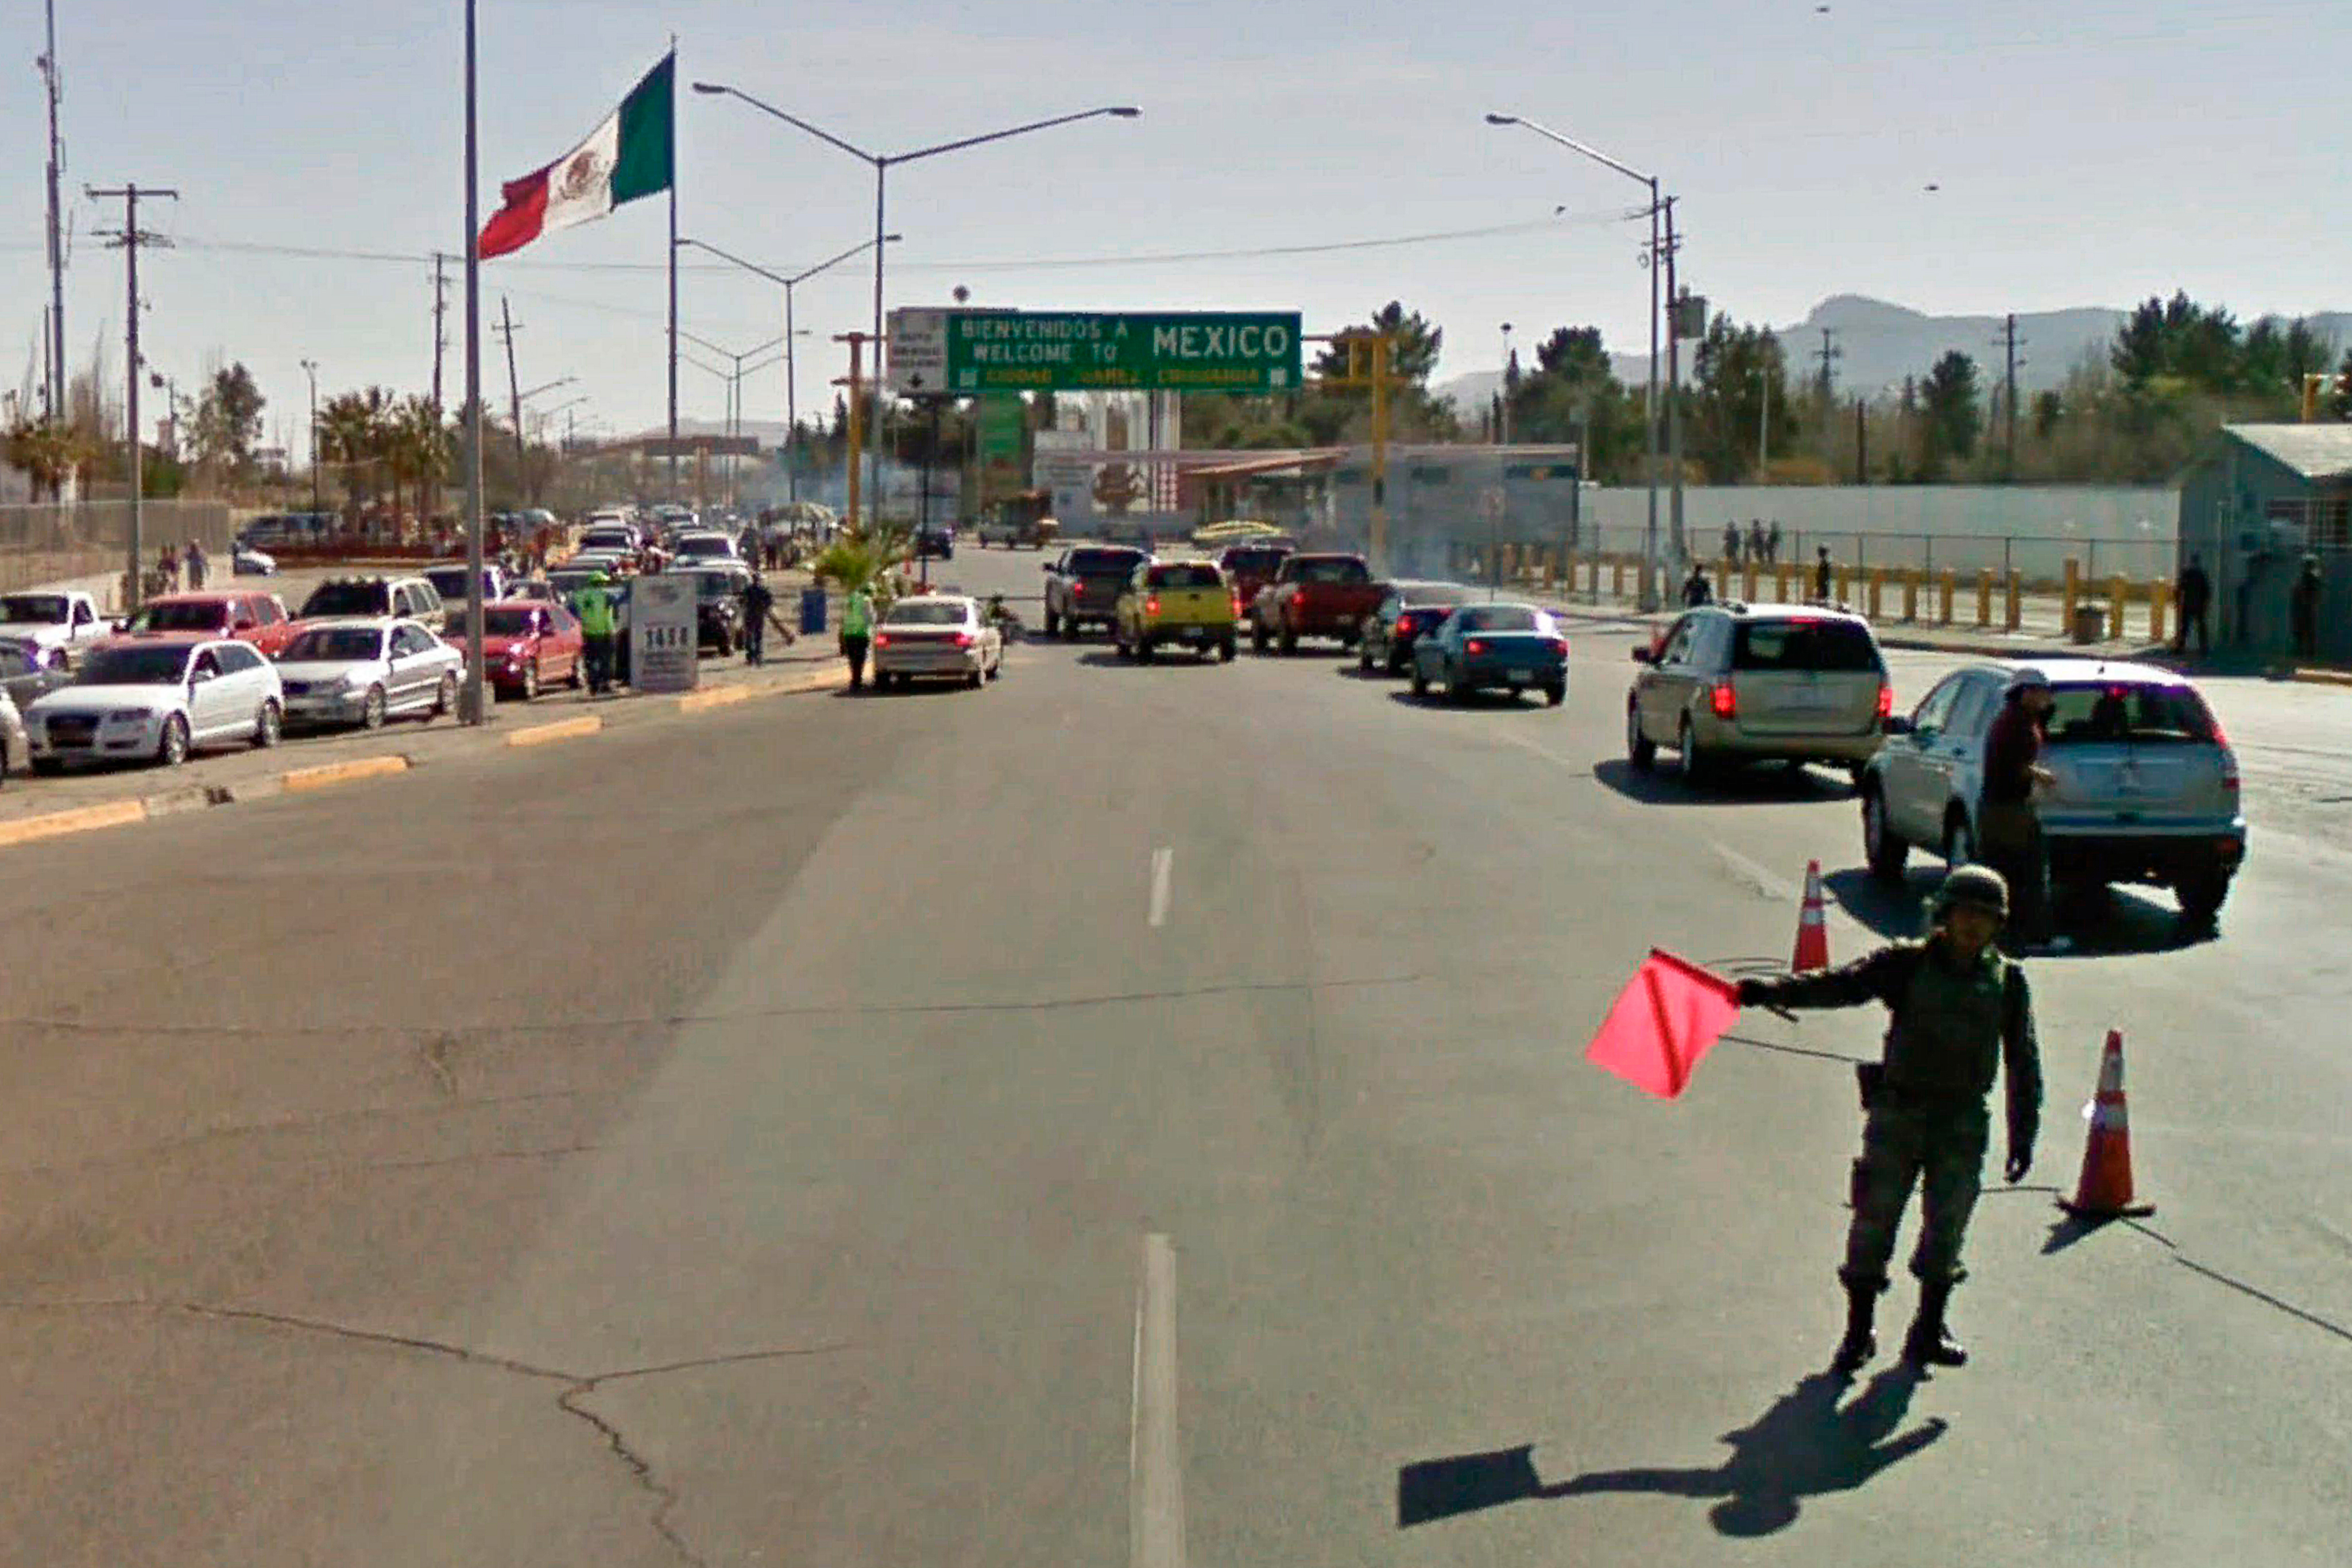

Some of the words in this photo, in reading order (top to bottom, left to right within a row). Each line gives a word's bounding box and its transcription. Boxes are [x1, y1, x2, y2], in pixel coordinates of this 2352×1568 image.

[961, 319, 1101, 339] BIENVENIDOS
[1115, 319, 1129, 339] A
[1152, 325, 1288, 358] MEXICO
[973, 343, 1073, 363] WELCOME
[1092, 343, 1119, 363] TO
